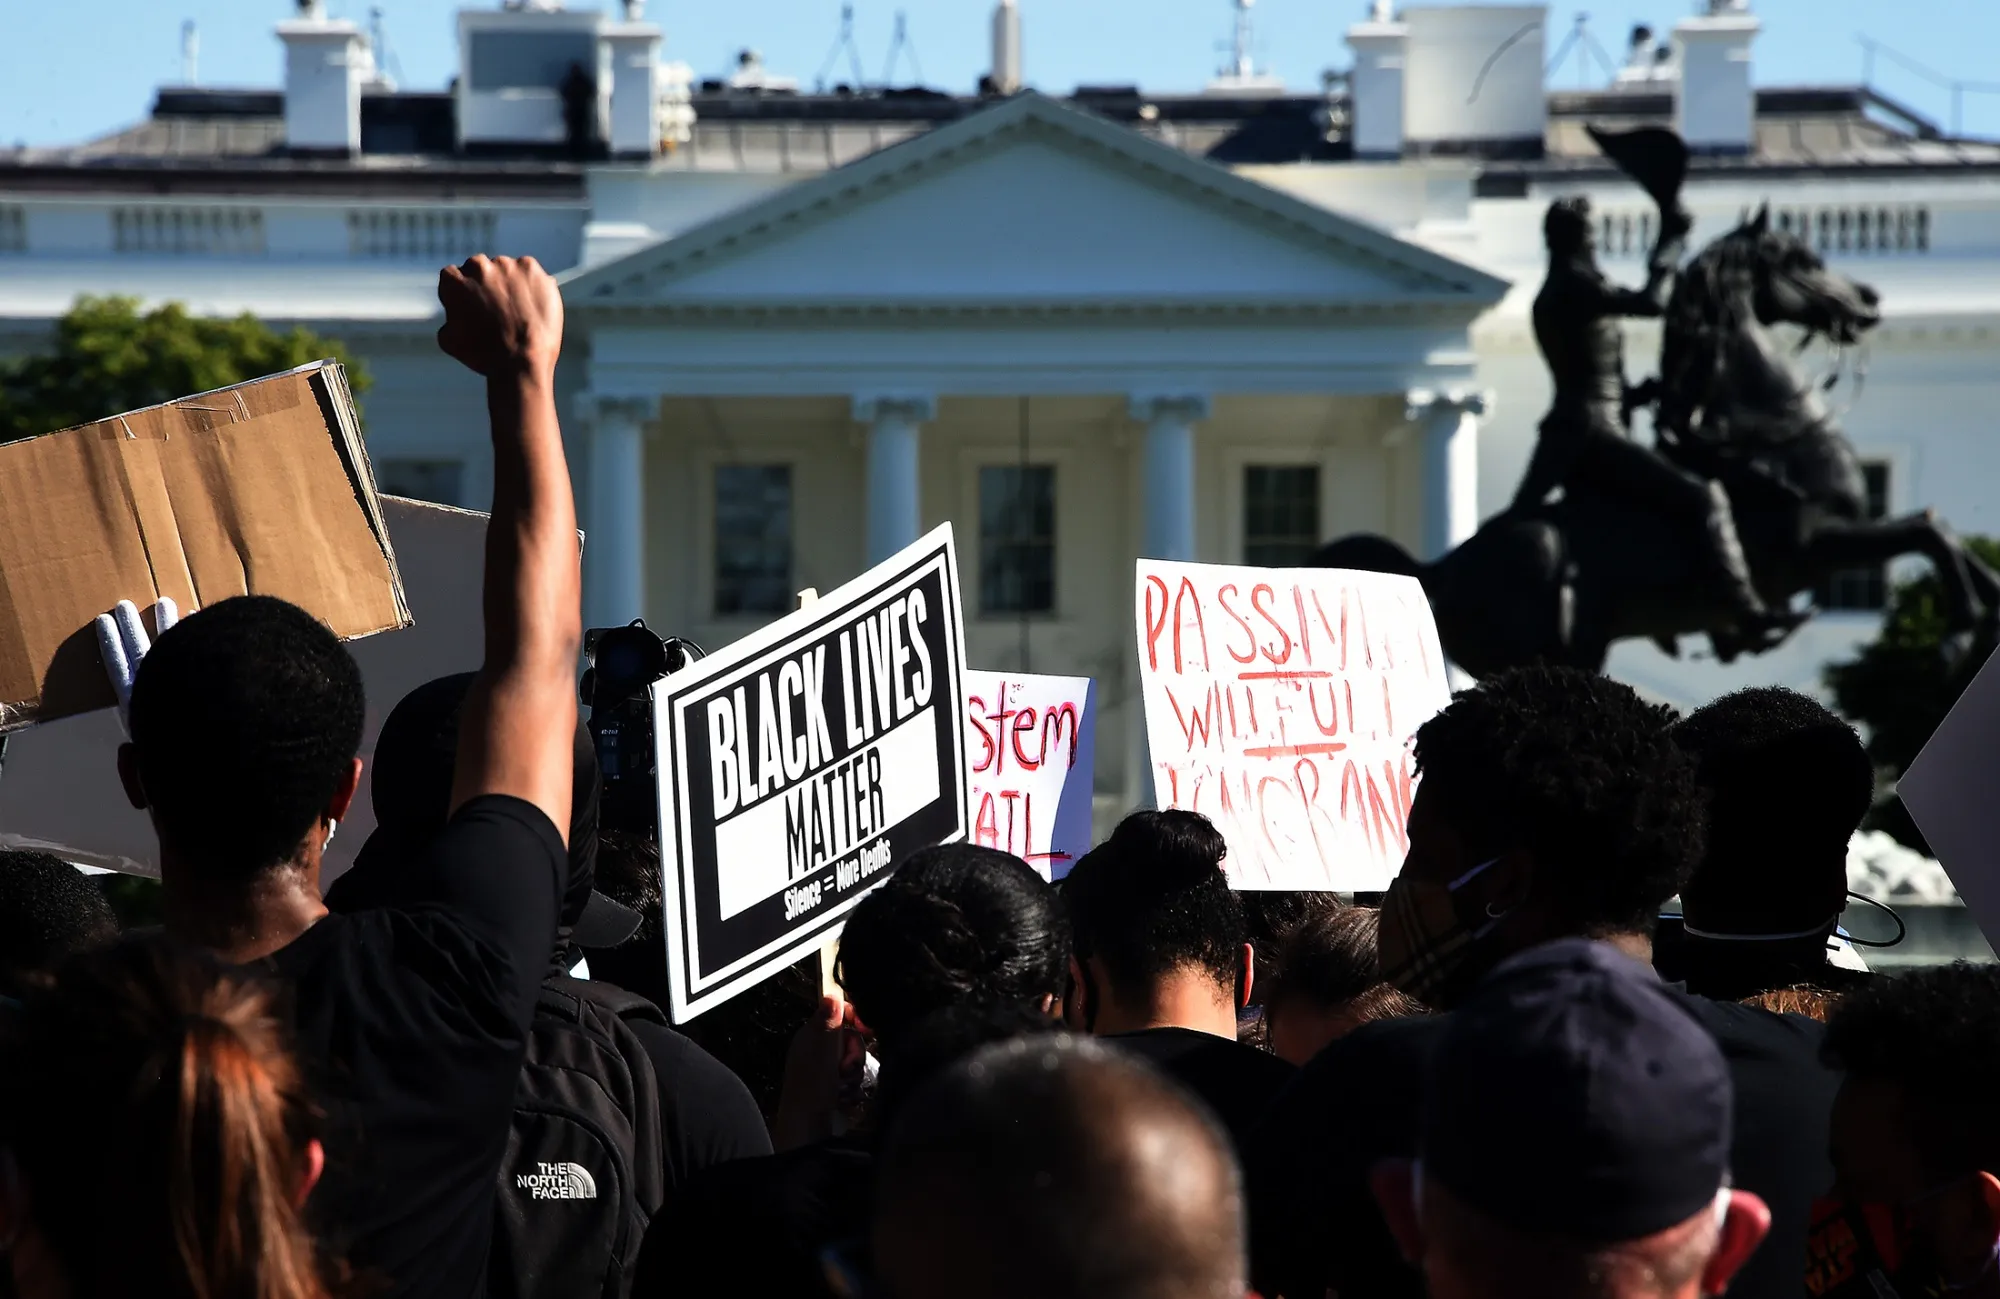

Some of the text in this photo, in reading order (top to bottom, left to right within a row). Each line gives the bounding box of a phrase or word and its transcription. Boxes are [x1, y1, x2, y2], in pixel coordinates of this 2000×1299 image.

[707, 588, 933, 821] BLACK LIVES
[784, 746, 885, 882] MATTER
[785, 838, 892, 922] Silence = More Deaths
[516, 1174, 568, 1188] NORTH
[537, 1162, 568, 1175] THE
[532, 1187, 569, 1200] FACE
